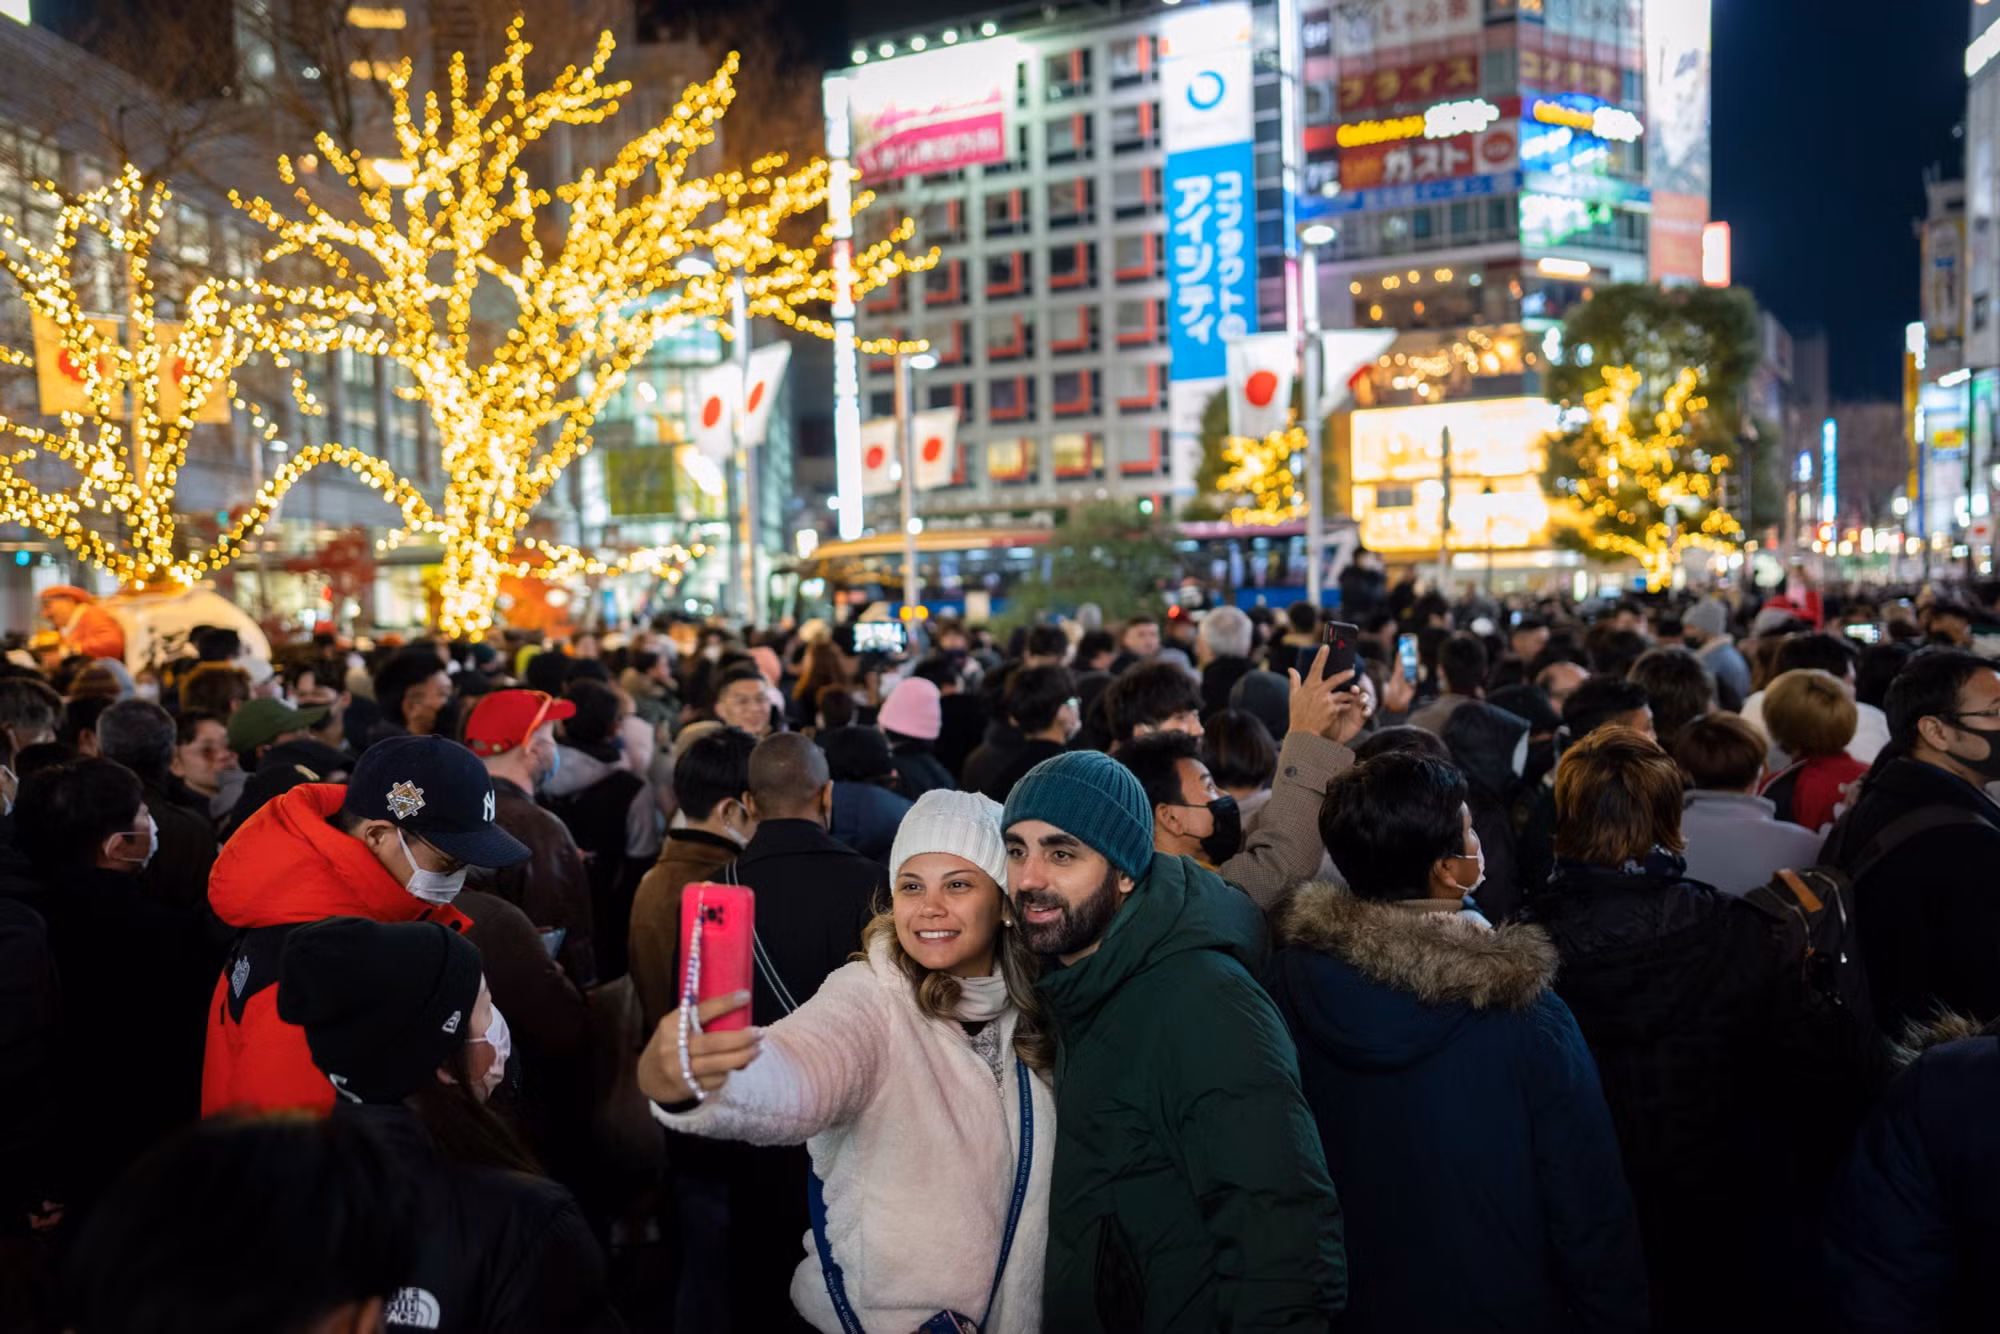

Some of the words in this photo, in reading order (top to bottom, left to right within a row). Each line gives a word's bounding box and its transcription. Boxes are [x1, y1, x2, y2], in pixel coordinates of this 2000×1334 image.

[1382, 142, 1469, 184] ガスト
[1173, 174, 1216, 345] アイシティ
[1023, 1127, 1031, 1157] COLORIDO
[386, 1310, 418, 1325] ACE
